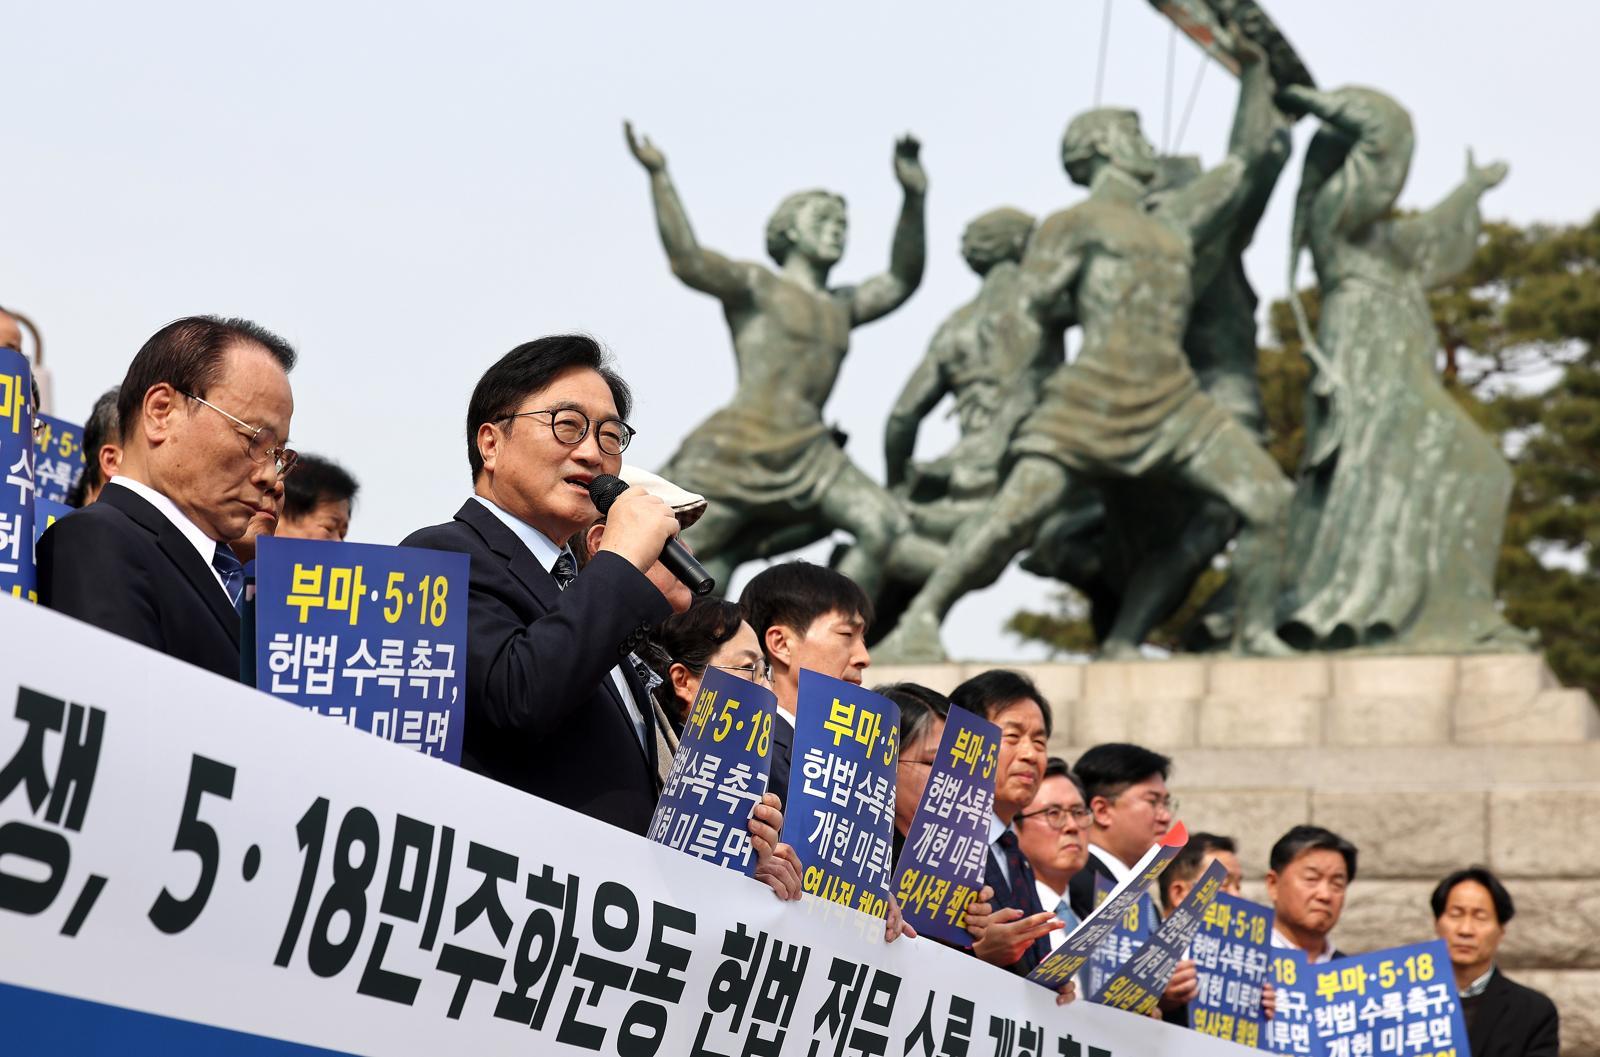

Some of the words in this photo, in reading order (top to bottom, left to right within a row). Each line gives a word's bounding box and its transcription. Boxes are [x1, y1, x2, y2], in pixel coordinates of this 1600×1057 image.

[286, 563, 449, 627] 부마·5·18
[269, 633, 338, 695] 헌법
[342, 638, 405, 698] 수록
[407, 640, 458, 704] 촉구,
[679, 752, 722, 805] 수록
[802, 747, 858, 808] 헌법
[854, 771, 889, 825] 수록
[923, 771, 963, 821] 헌법
[955, 785, 987, 830] 수록
[808, 809, 855, 867] 개헌
[913, 822, 954, 868] 개헌
[0, 684, 108, 938] 쟁,
[690, 922, 811, 1057] 헌법
[896, 867, 952, 920] 역사적
[1192, 933, 1221, 970] 헌법
[1219, 943, 1245, 977] 수록
[1315, 953, 1434, 1002] 부마·5·18
[1225, 980, 1262, 1019] 미루면
[1314, 1000, 1357, 1038] 헌법
[1358, 990, 1406, 1027] 수록
[1380, 1015, 1452, 1056] 미루면
